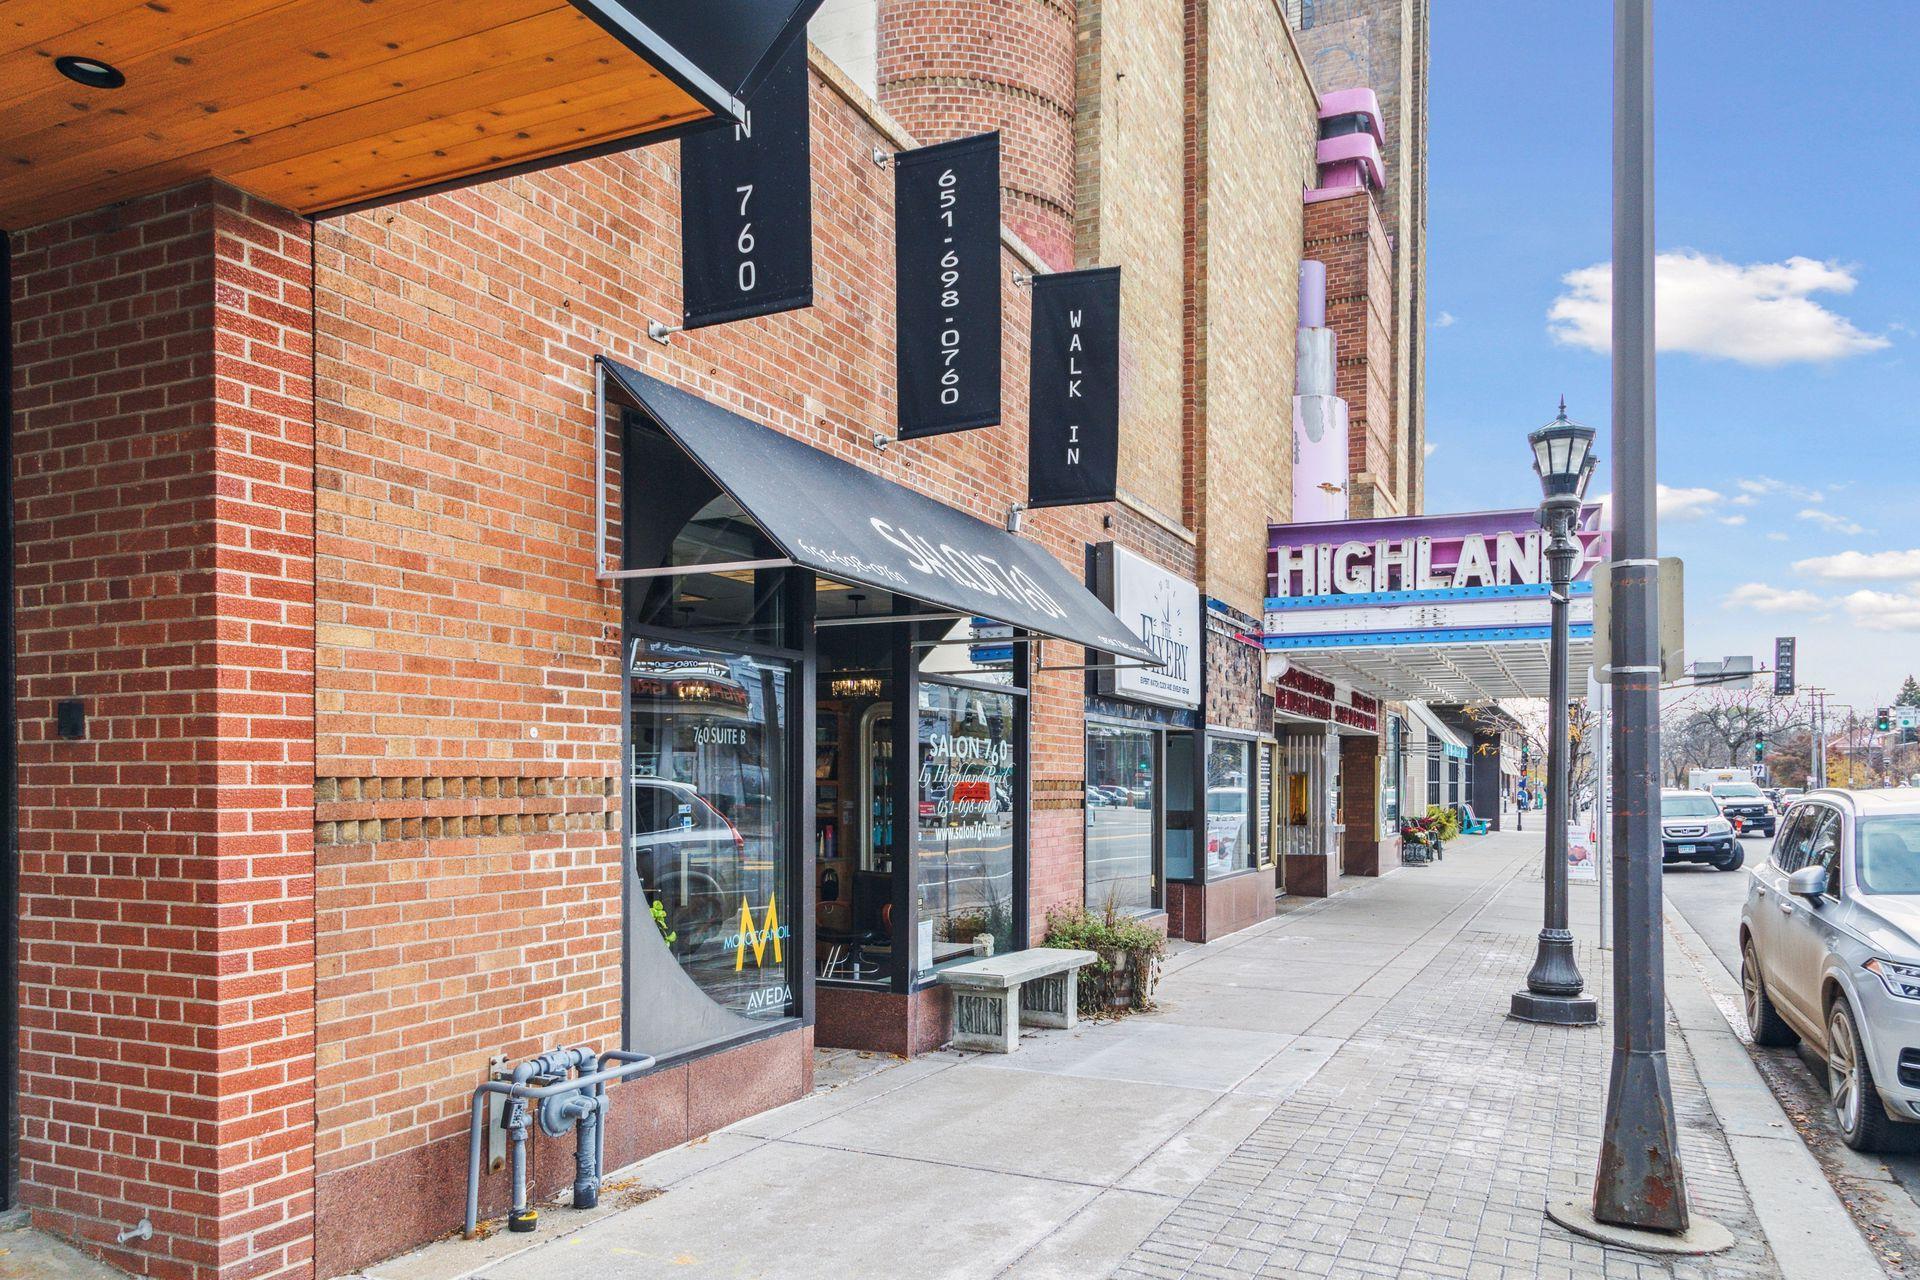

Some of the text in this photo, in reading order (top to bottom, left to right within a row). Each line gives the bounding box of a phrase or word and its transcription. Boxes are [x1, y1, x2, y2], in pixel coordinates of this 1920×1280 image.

[736, 184, 756, 292] 760
[1067, 309, 1082, 465] WALK IN
[869, 517, 1022, 604] SALON
[693, 726, 746, 746] 760 SUITE B
[929, 733, 1008, 766] SALON 760
[931, 762, 988, 793] Highland
[985, 763, 1016, 789] Park
[935, 820, 1001, 841] www.salon760.com
[747, 984, 792, 1010] AVEDA
